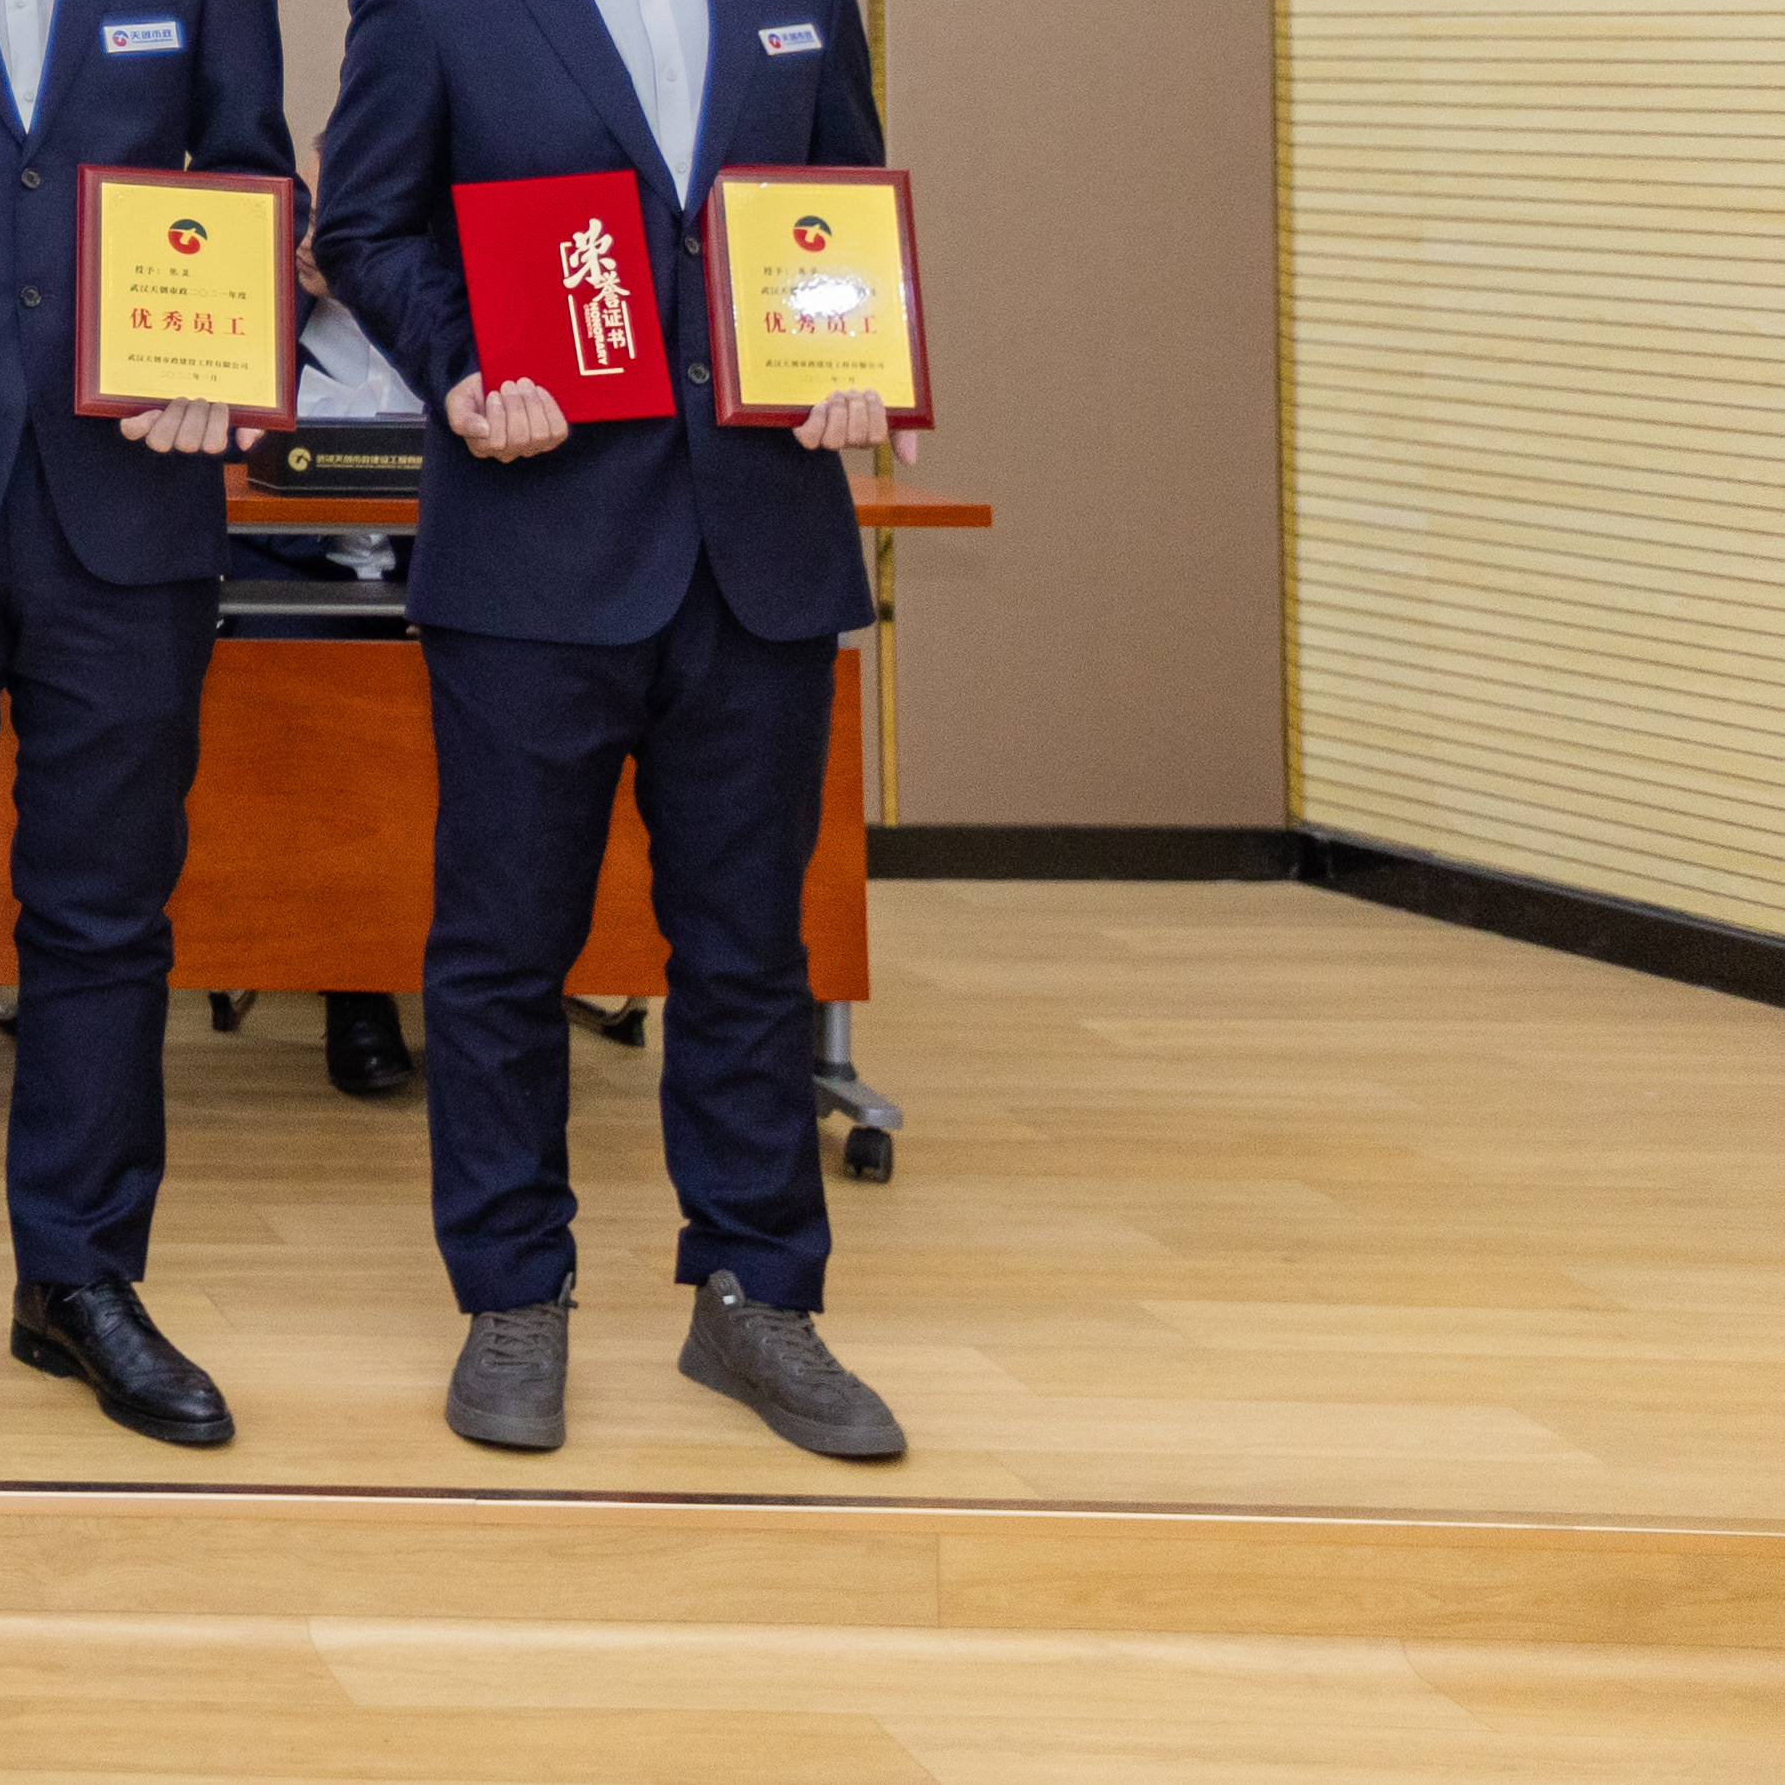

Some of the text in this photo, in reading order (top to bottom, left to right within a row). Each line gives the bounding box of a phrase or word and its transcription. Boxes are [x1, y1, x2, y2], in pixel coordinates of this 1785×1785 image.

[562, 218, 631, 349] 荣誉证书
[130, 307, 246, 336] 优秀员工
[589, 301, 608, 366] HONORARY
[763, 311, 878, 335] 优秀员工
